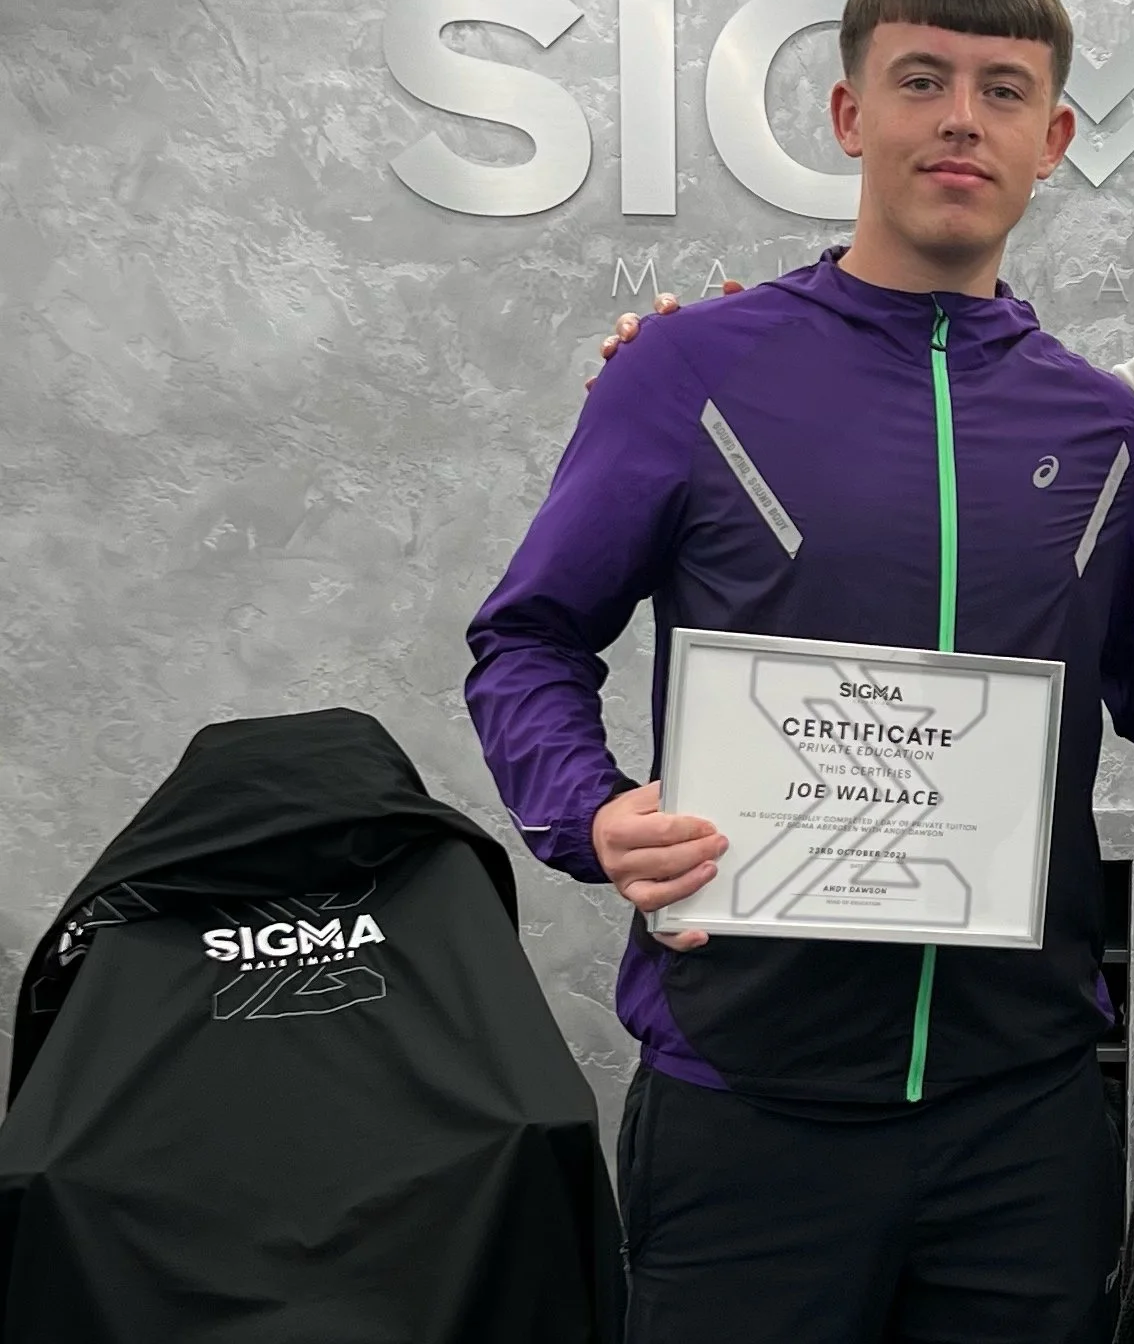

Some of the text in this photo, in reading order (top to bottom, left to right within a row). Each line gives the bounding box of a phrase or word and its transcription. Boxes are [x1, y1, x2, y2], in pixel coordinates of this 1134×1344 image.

[747, 476, 773, 508] SOUND
[767, 507, 789, 532] BODY
[840, 682, 903, 702] SIGMA
[782, 716, 952, 747] CERTIFICATE
[798, 741, 935, 761] PRIVATE EDUCATION
[818, 763, 912, 779] THIS CERTIFIES
[785, 781, 939, 806] JOE WALLACE
[739, 810, 757, 819] HAS
[759, 811, 821, 823] SUCCESSFULLY
[823, 815, 873, 826] COMPLETED
[880, 818, 898, 827] DAY
[911, 820, 944, 830] PRIVATE
[946, 822, 978, 832] TUITION
[787, 821, 814, 830] SIGMA
[816, 823, 858, 833] ABERDEEN
[860, 825, 883, 834] WITH
[908, 828, 944, 838] DAWSON
[808, 846, 834, 856] 23RD
[837, 848, 881, 858] OCTOBER
[822, 885, 888, 895] ANDY DAWSON
[202, 913, 387, 962] SIGMA
[239, 949, 356, 972] MALE IMAGE
